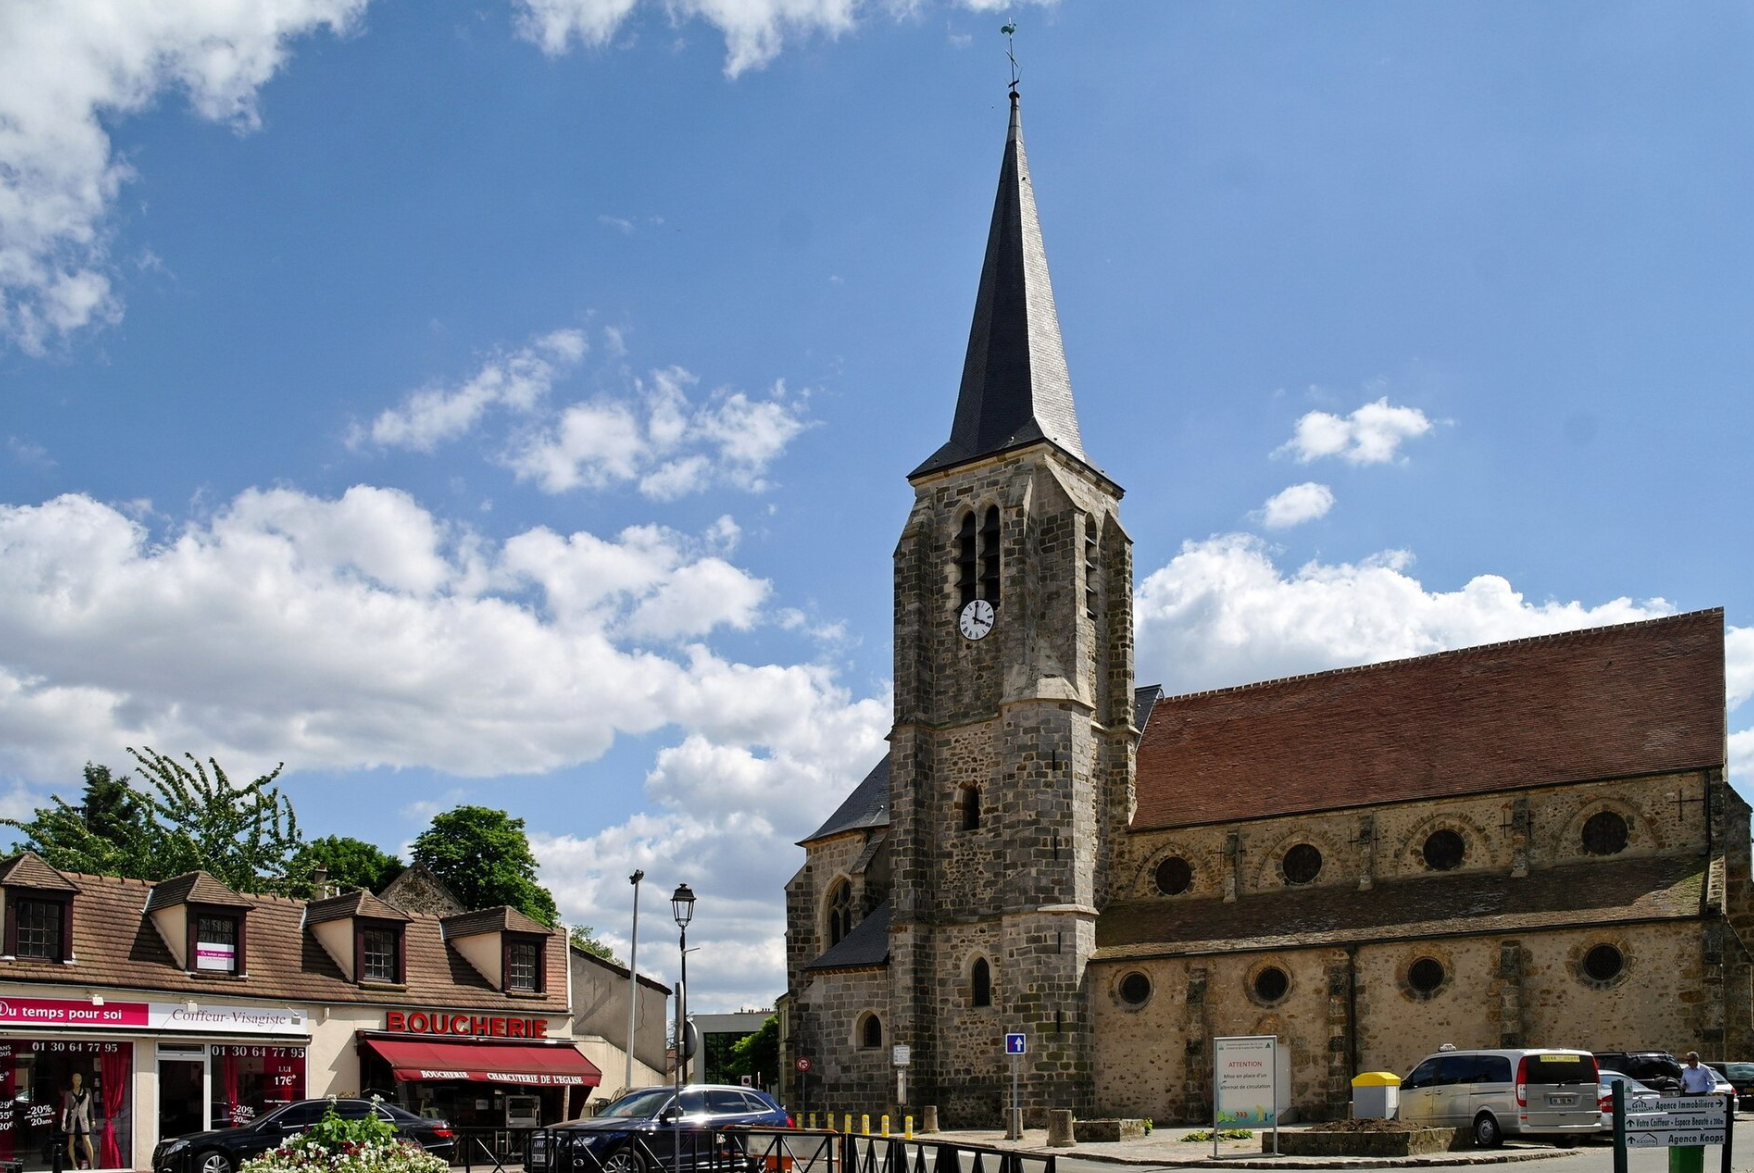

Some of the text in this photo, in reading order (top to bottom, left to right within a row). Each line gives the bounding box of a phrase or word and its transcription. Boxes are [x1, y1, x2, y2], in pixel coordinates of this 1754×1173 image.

[22, 1007, 64, 1020] temps
[68, 1009, 100, 1020] pour
[103, 1010, 122, 1020] soi
[386, 1011, 548, 1039] BOUCHERIE
[32, 1042, 118, 1053] 01 30 64 77 95
[211, 1045, 305, 1058] 01 30 64 77 95
[420, 1070, 469, 1079] BOUCHERIE
[486, 1072, 538, 1084] CHARCUTERIE
[540, 1075, 551, 1084] DE
[1655, 1101, 1677, 1111] Agence
[1668, 1134, 1697, 1144] Agence
[1700, 1132, 1724, 1143] Keops
